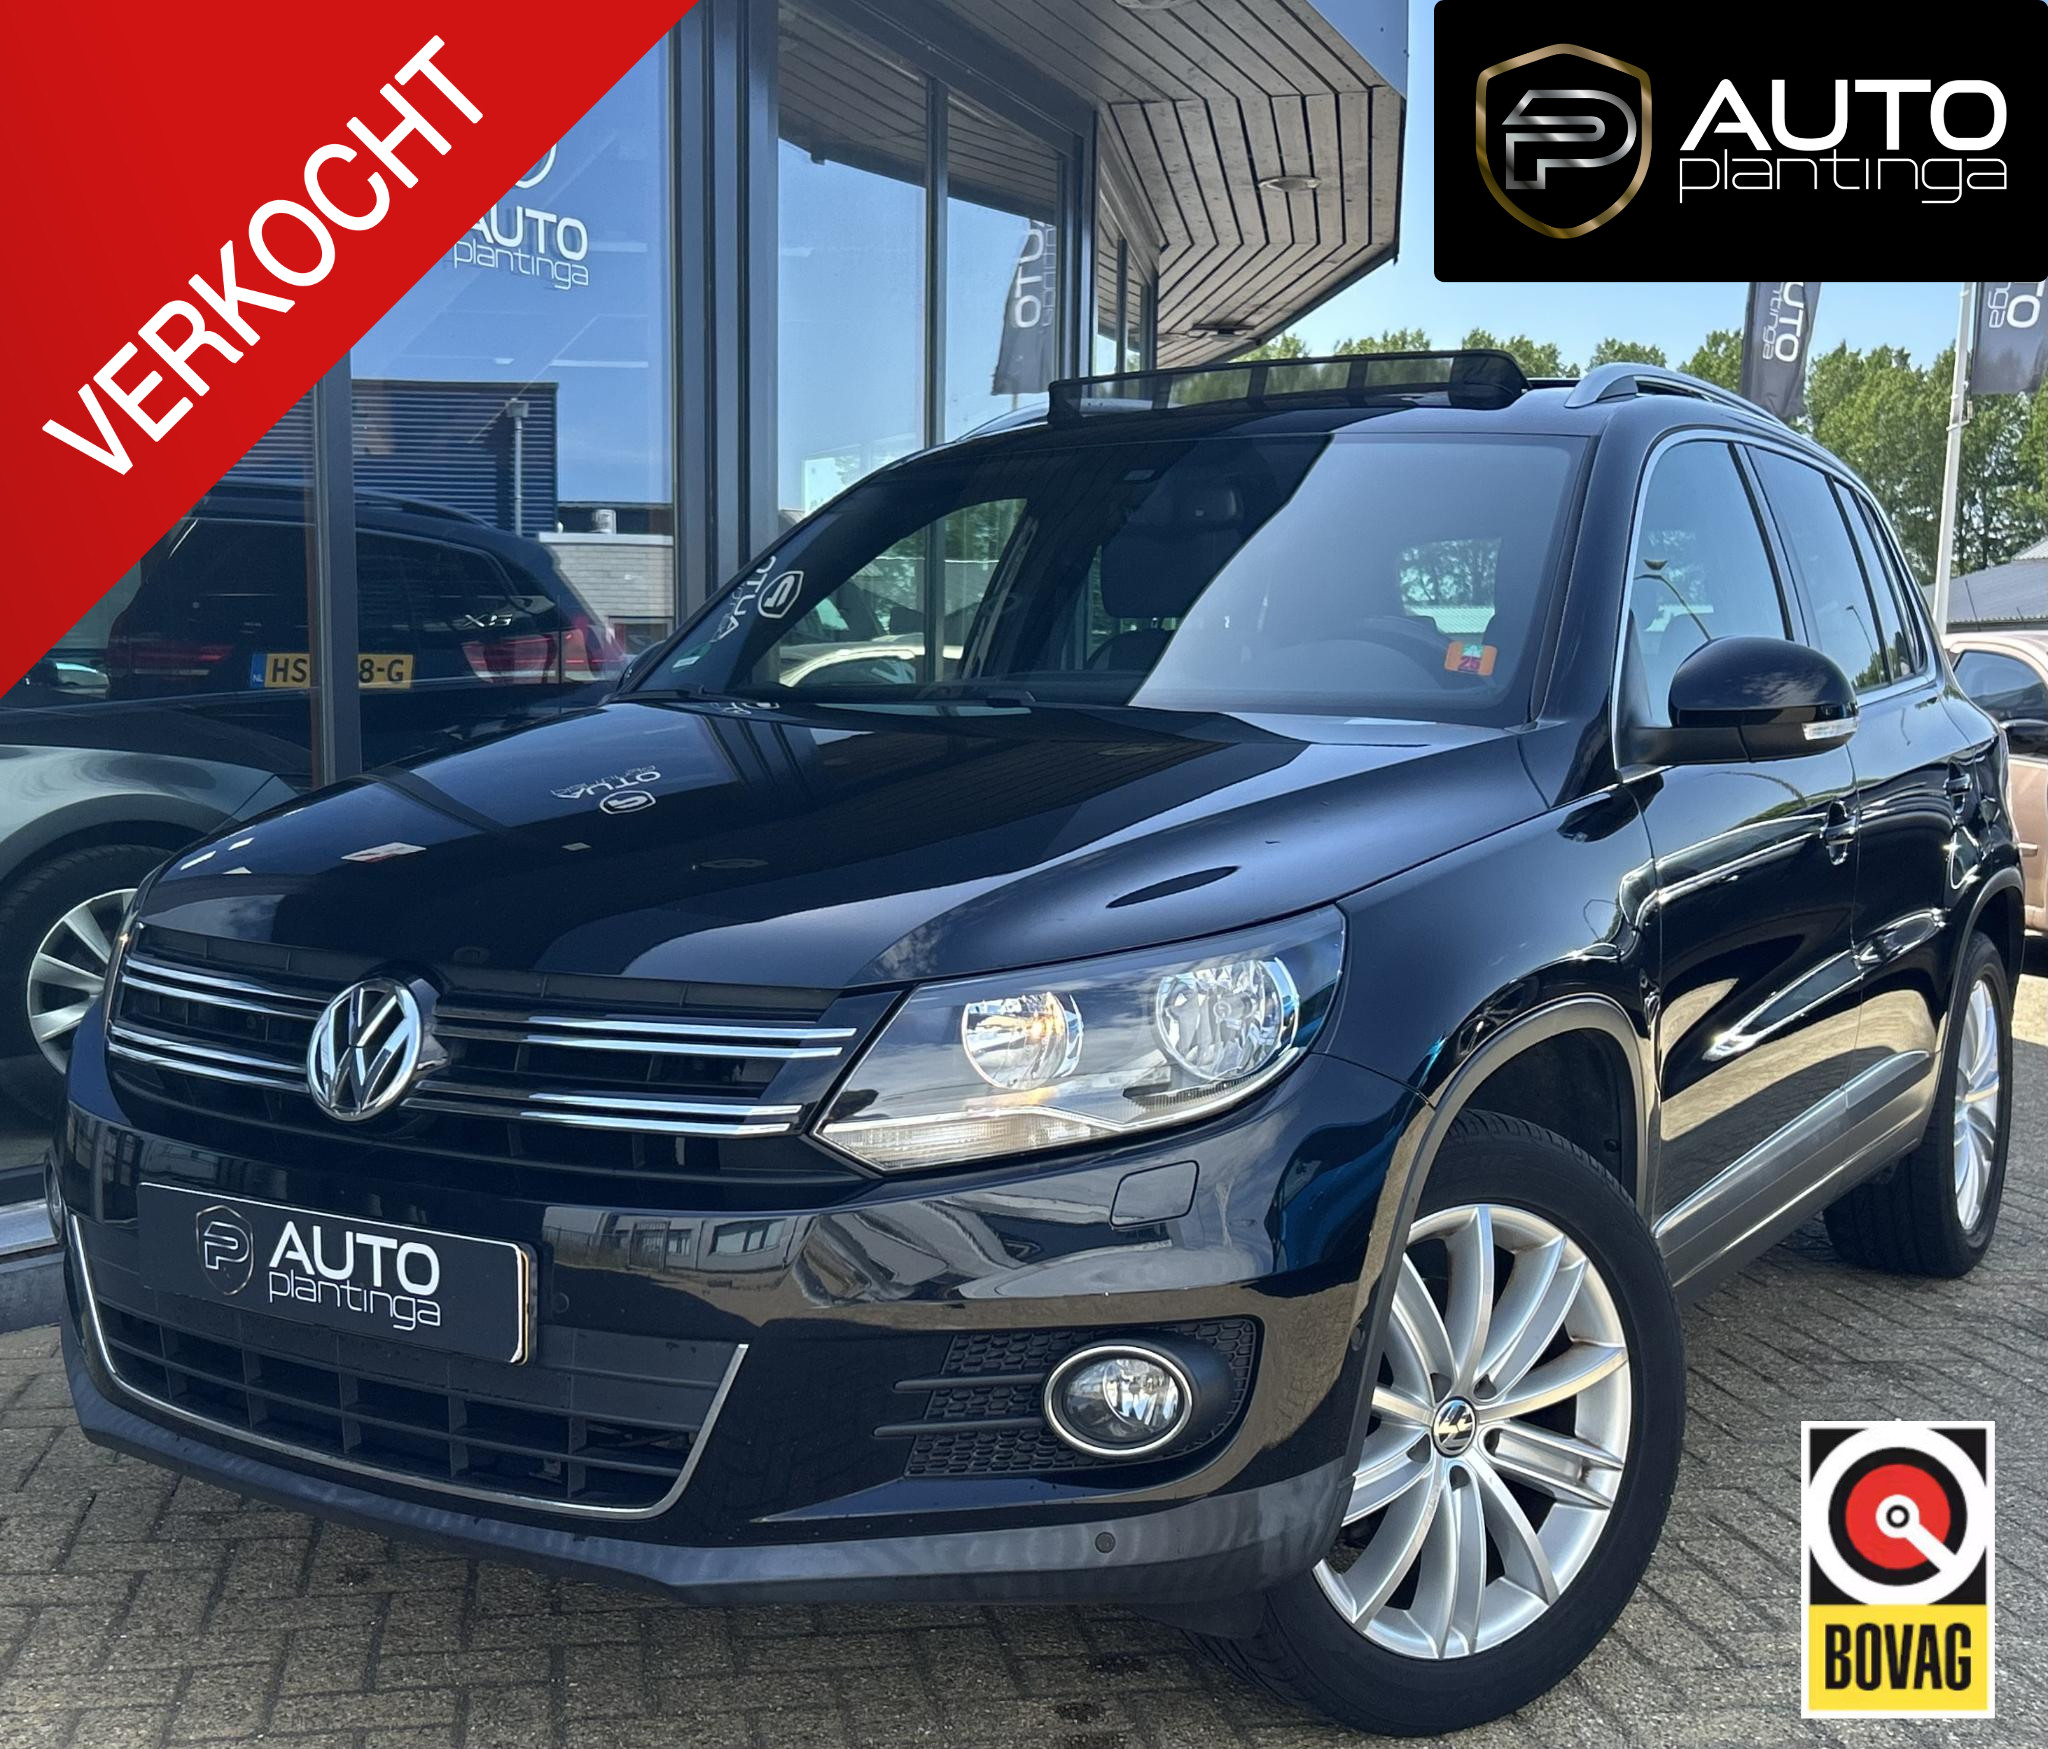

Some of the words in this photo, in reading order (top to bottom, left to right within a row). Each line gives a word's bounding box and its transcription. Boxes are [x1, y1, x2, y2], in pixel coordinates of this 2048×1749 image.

[454, 238, 589, 290] plantinga
[269, 1220, 440, 1296] AUTO
[269, 1269, 441, 1331] plantinga
